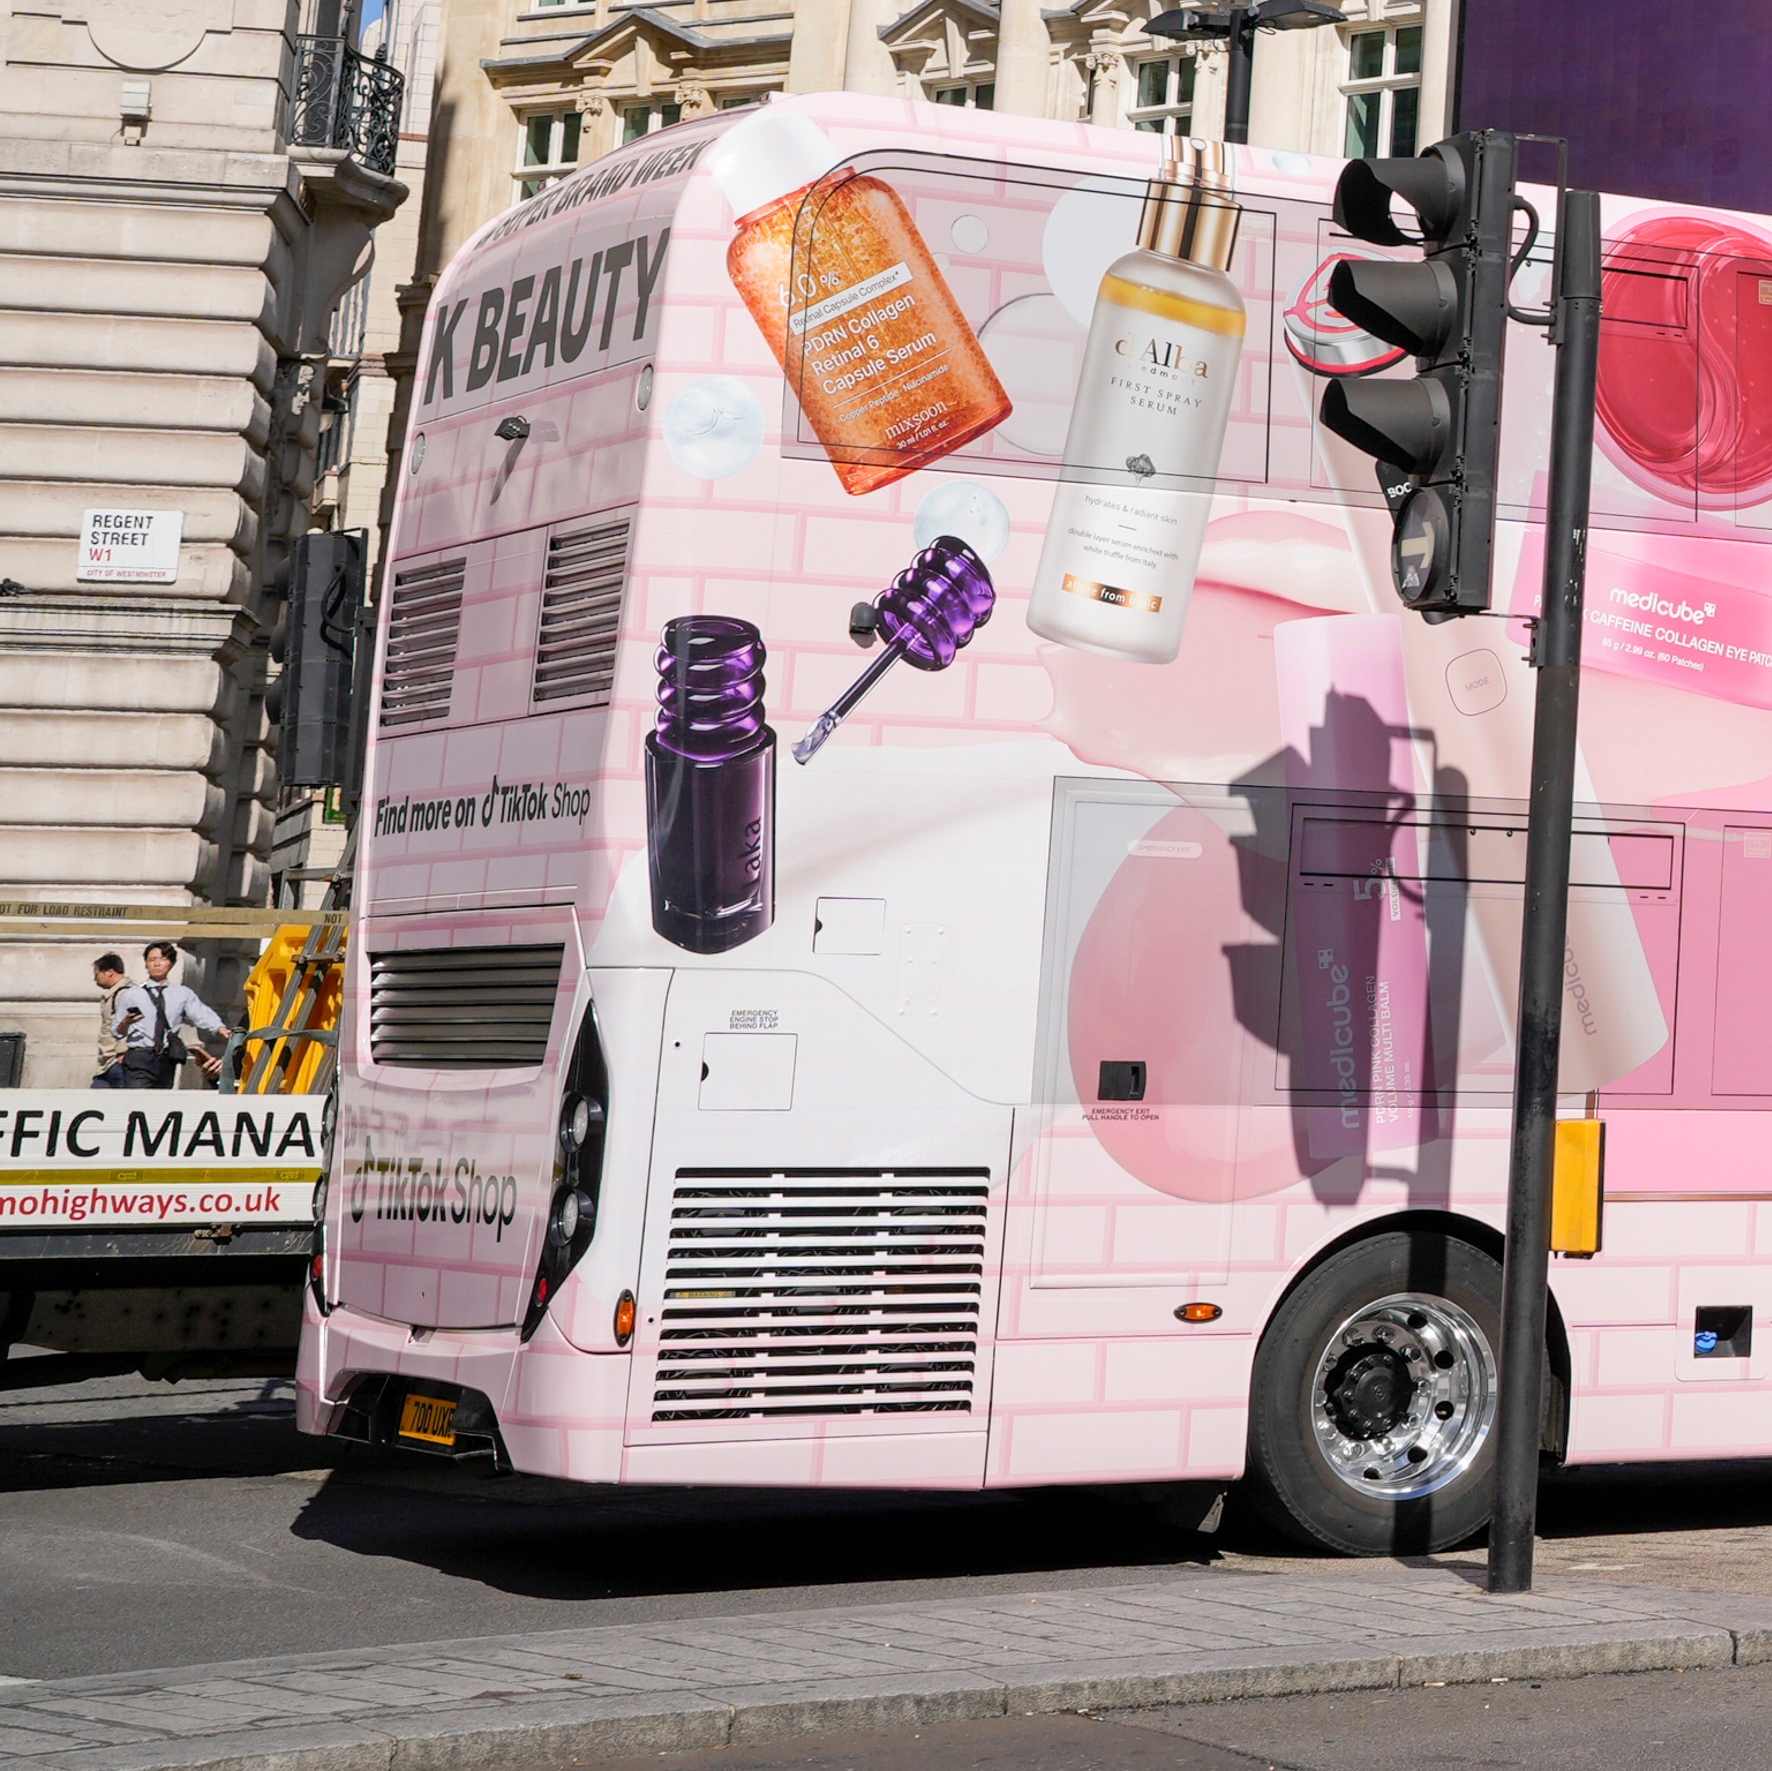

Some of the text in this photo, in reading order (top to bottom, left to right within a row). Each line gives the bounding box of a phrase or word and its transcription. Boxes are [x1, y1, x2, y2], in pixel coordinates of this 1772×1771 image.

[551, 160, 636, 215] BRAND
[630, 136, 718, 188] WEEK
[423, 226, 671, 405] K BEAUTY
[801, 293, 916, 357] PDRN Collagen
[811, 334, 880, 376] Retinal 6
[822, 332, 937, 395] Capsule Serum
[1111, 376, 1202, 408] FIRST SPRAY
[1130, 395, 1177, 416] SERUM
[885, 400, 948, 440] mixsoon
[91, 531, 148, 546] STREET
[93, 515, 154, 529] REGENT
[89, 548, 111, 561] W1
[116, 570, 167, 578] WESTMINSTER
[1609, 588, 1705, 625] medicube
[1590, 610, 1654, 638] CAFFEINE
[1655, 627, 1725, 656] COLLAGEN
[1725, 647, 1747, 662] EYE
[375, 782, 590, 837] Find more on TikTok Shop
[17, 904, 38, 915] FOR
[43, 905, 69, 916] LOAD
[74, 905, 128, 917] RESTRAINT
[324, 913, 343, 924] NOT
[377, 1157, 517, 1243] TikTok Shop
